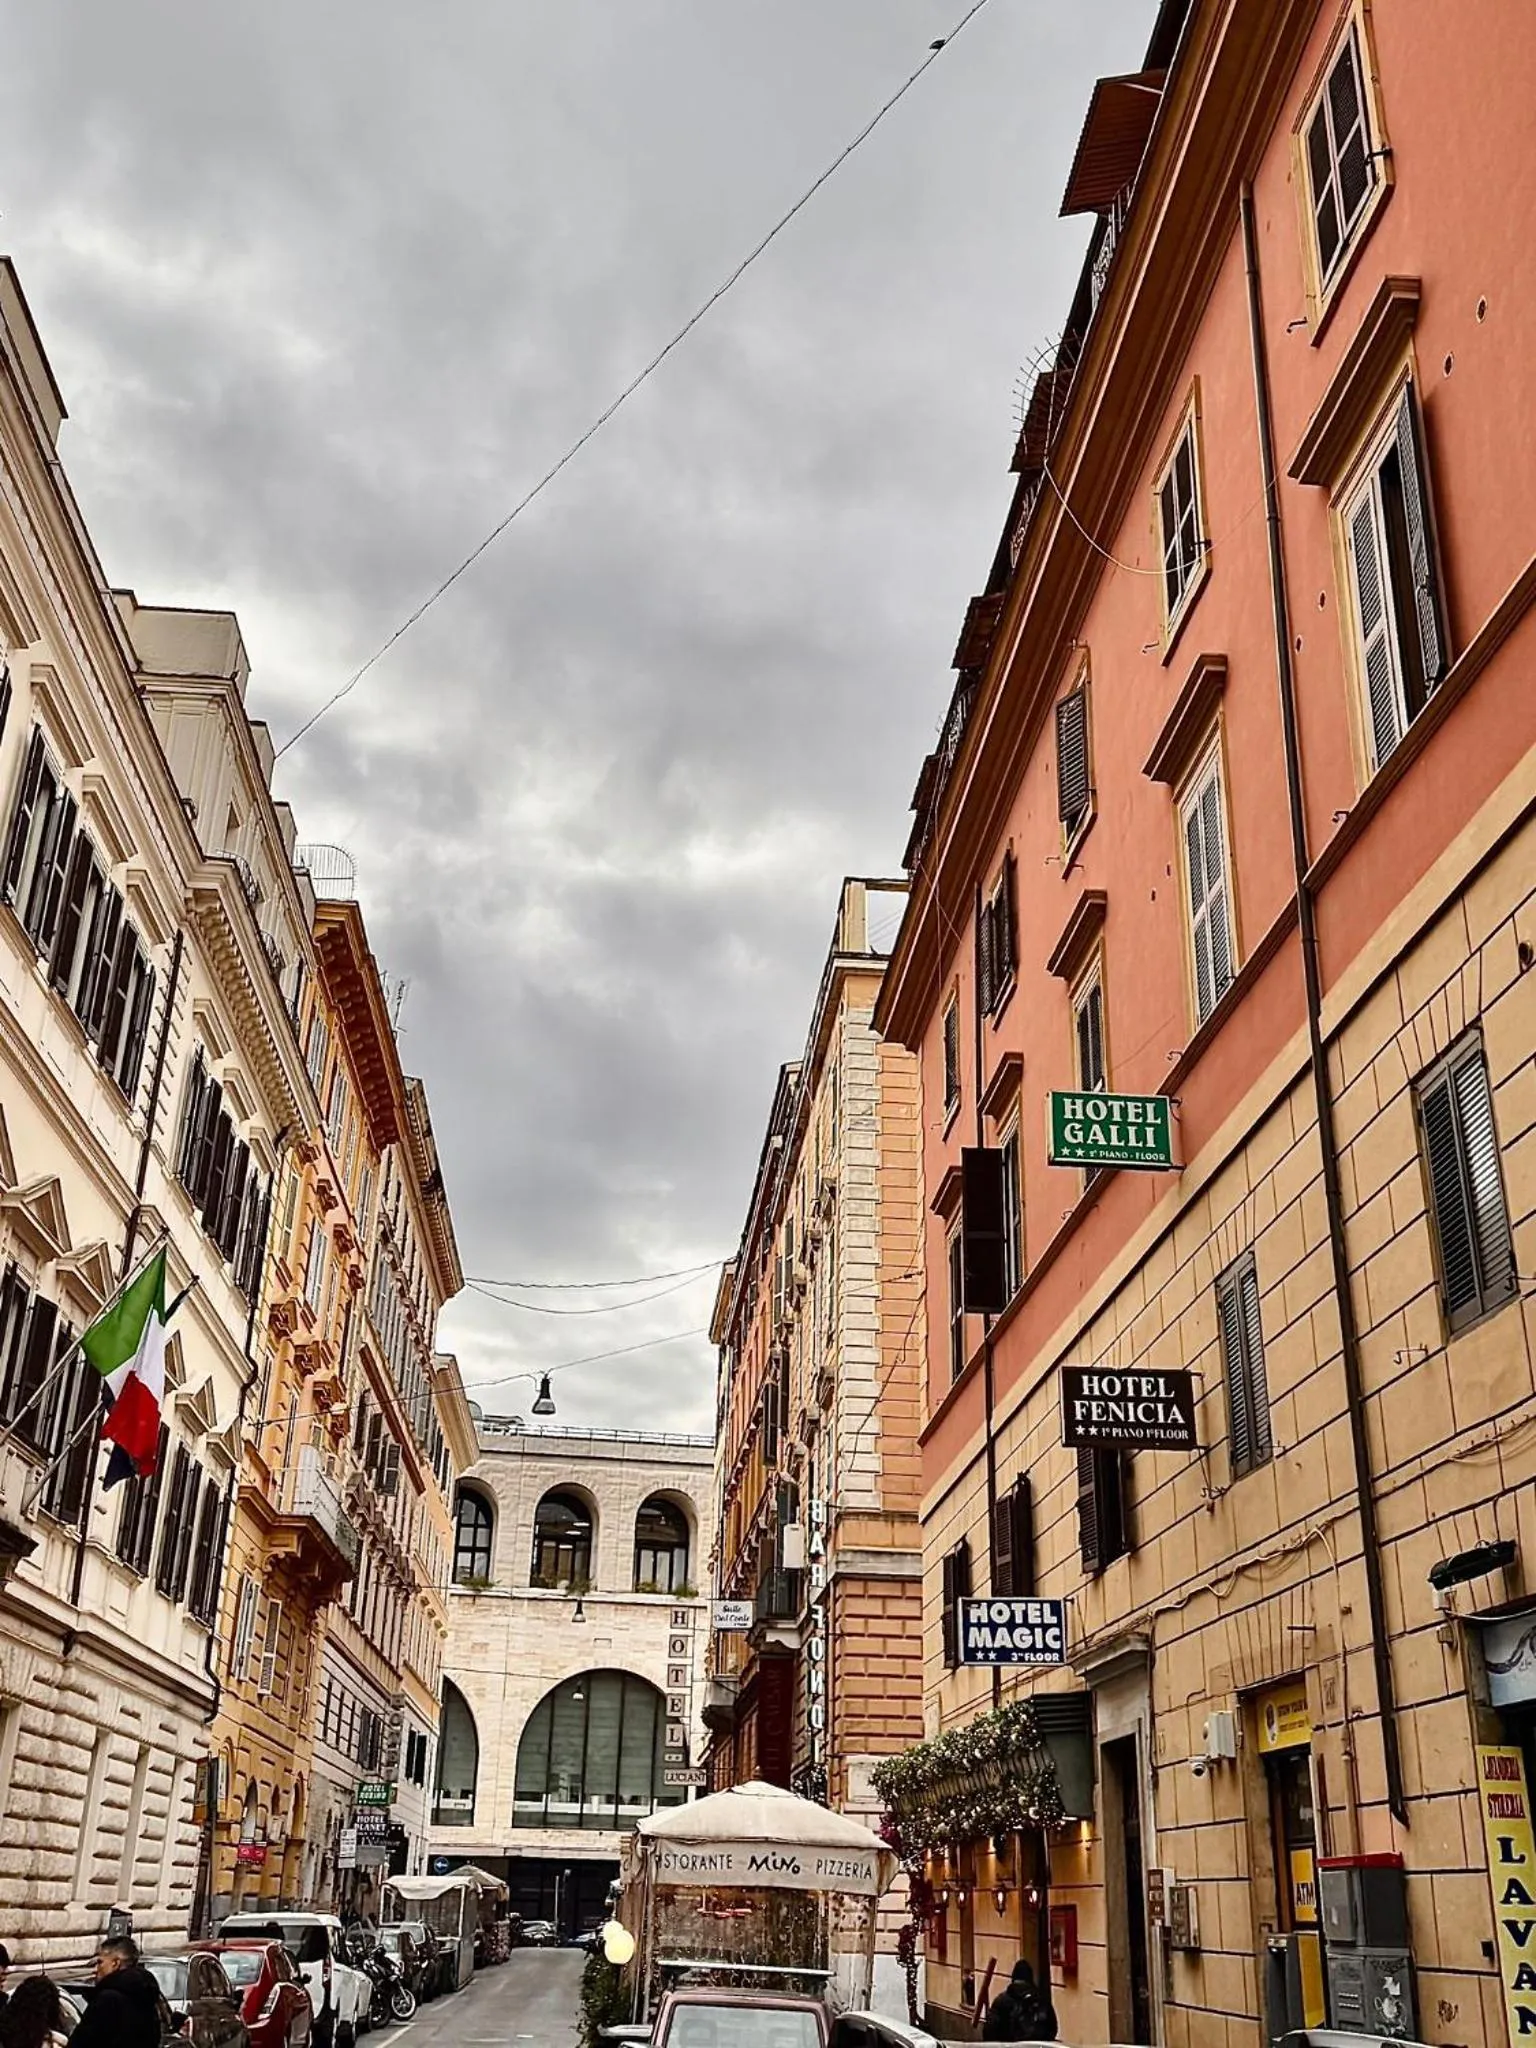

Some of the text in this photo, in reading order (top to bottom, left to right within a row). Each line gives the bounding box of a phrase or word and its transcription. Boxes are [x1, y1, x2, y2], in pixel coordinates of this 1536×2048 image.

[1063, 1098, 1161, 1124] HOTEL
[1064, 1122, 1156, 1148] GALLI
[1081, 1375, 1175, 1398] HOTEL
[1074, 1400, 1185, 1424] FENICIA
[1112, 1427, 1144, 1439] PIANO
[970, 1602, 1058, 1625] HOTEL
[967, 1627, 1062, 1650] MAGIC
[1024, 1652, 1061, 1662] FLOOR
[668, 1610, 686, 1743] HOTEL
[355, 1823, 387, 1832] PLANET
[357, 1815, 384, 1824] HOTEL
[816, 1858, 873, 1880] PIZZERIA
